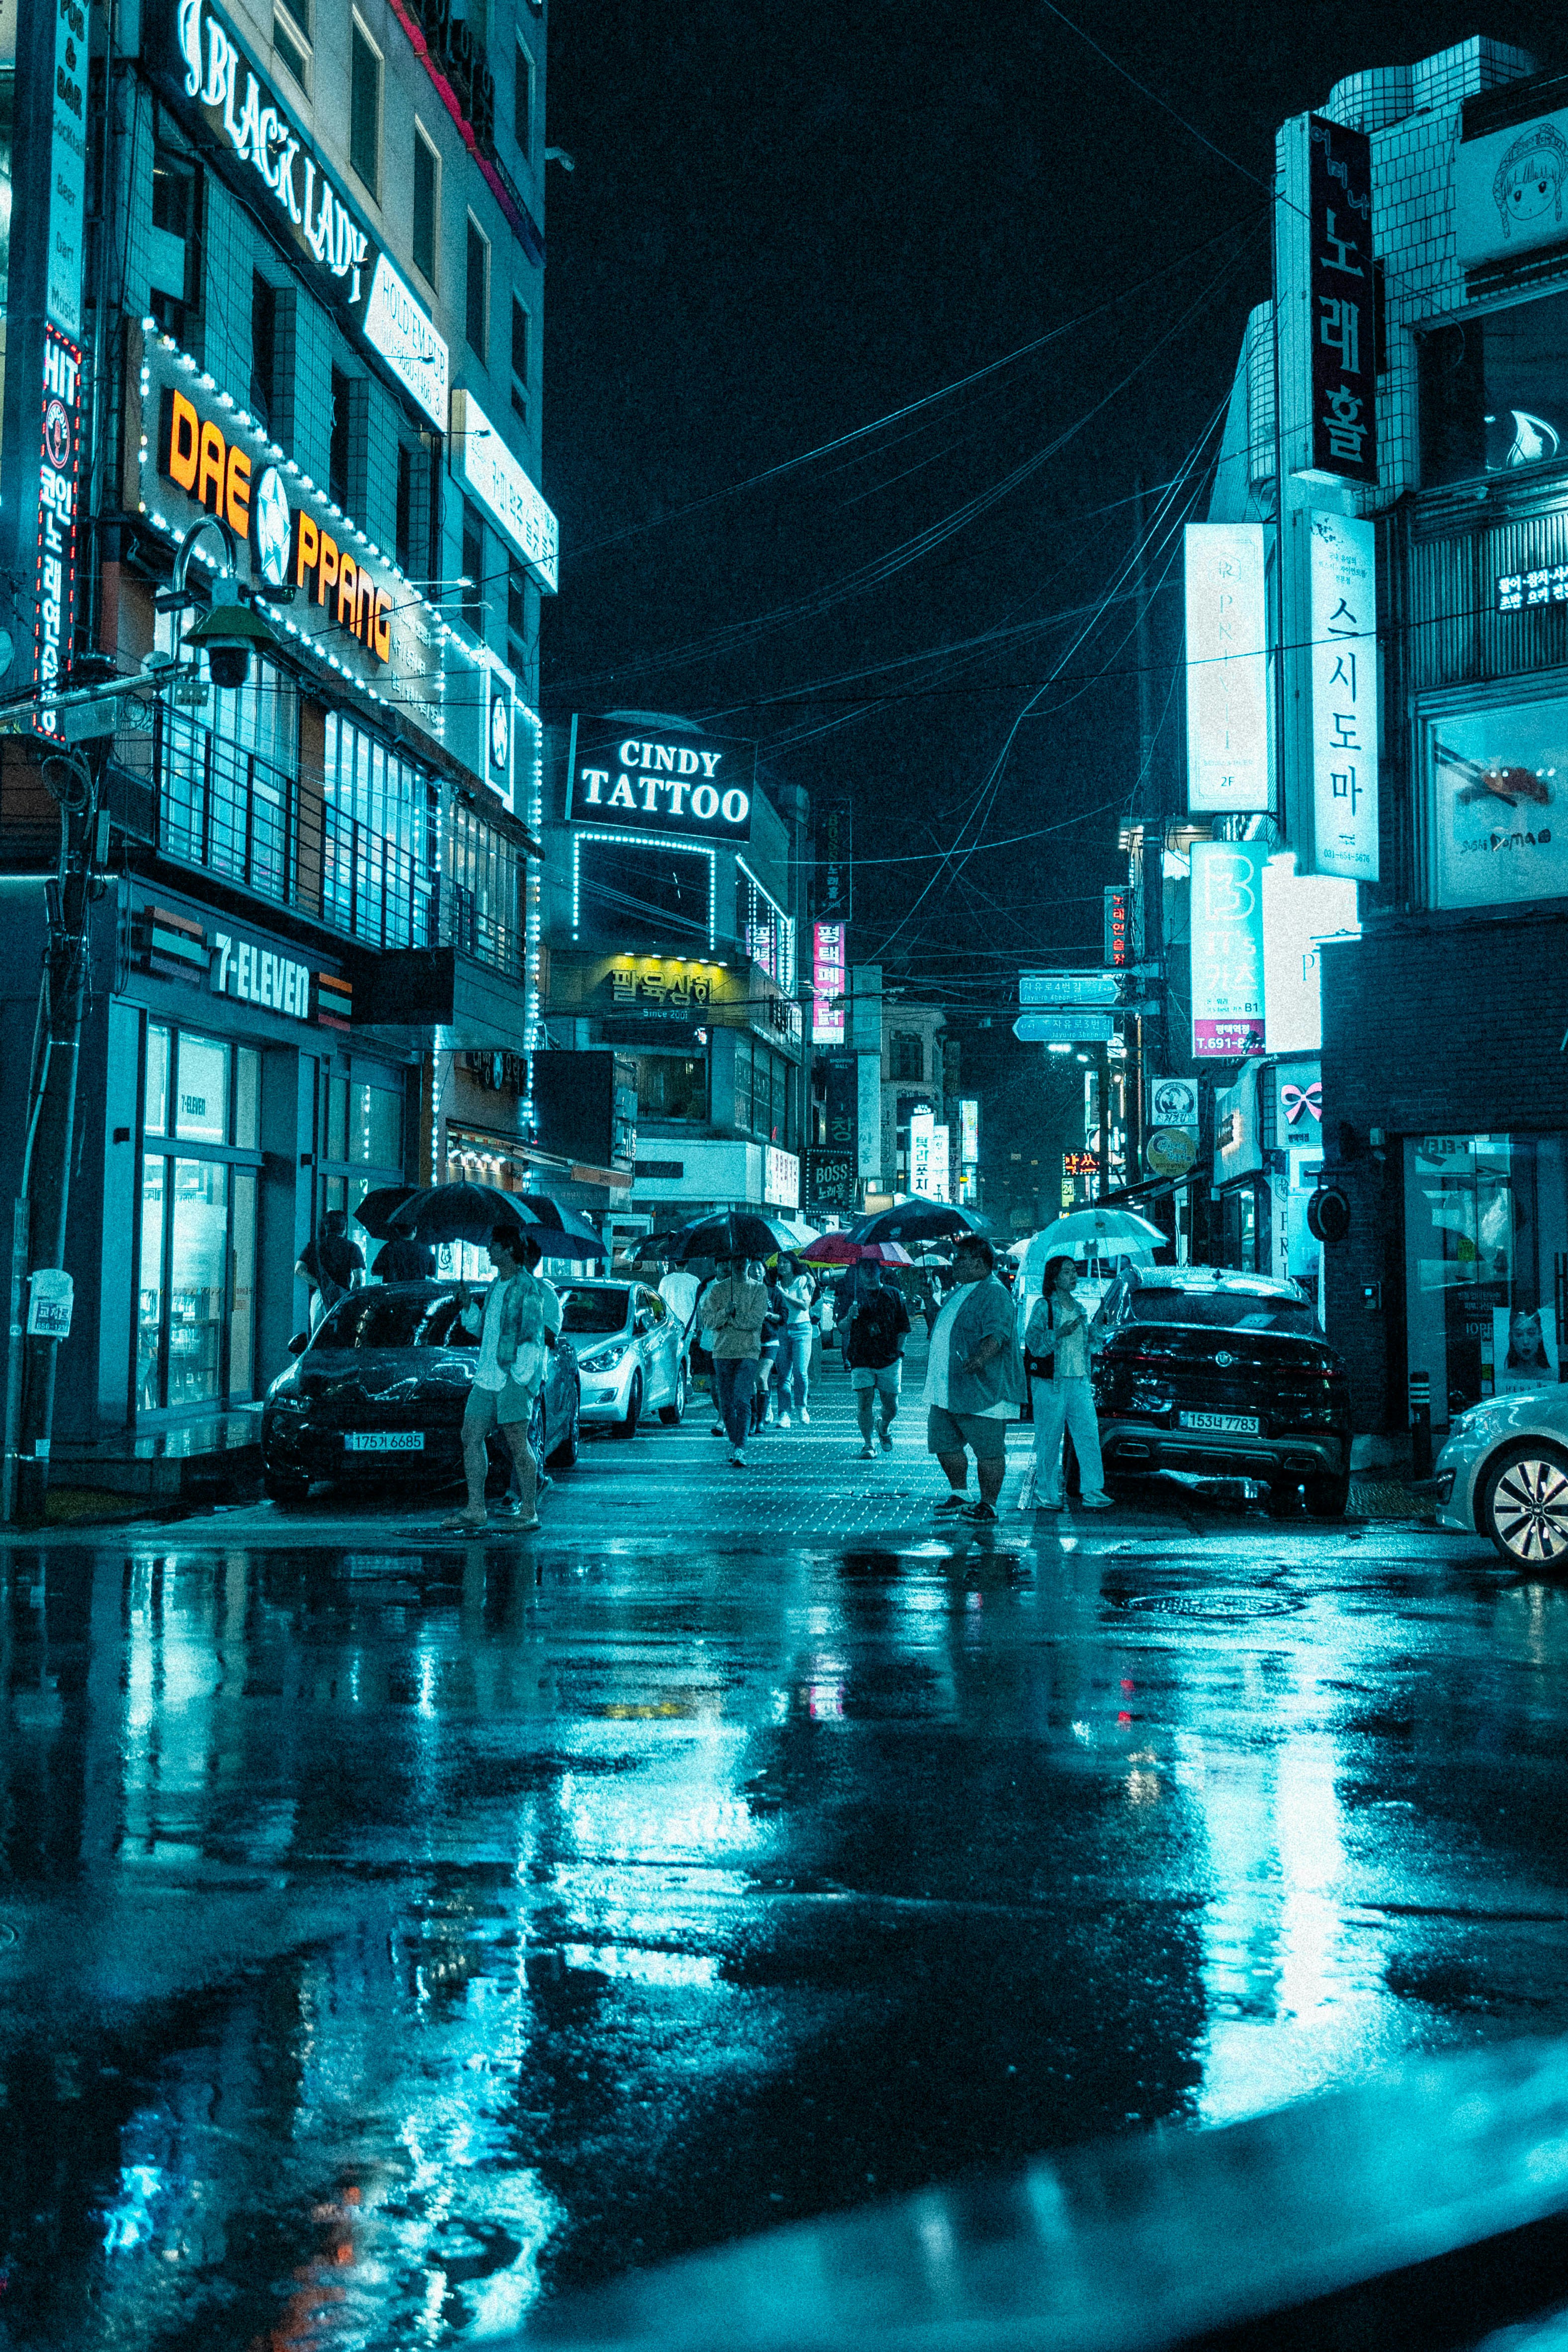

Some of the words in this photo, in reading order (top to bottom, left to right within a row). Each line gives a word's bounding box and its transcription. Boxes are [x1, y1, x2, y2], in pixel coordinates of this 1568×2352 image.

[57, 65, 83, 120] BAR
[201, 16, 301, 224] BLACK
[304, 157, 368, 303] LADY
[1320, 207, 1365, 464] 노래홀
[45, 338, 78, 406] HIT
[170, 389, 251, 539] DAE
[297, 509, 393, 664] PPANG
[1327, 598, 1363, 817] 스시도마
[618, 740, 722, 778] CINDY
[581, 768, 750, 823] TATTOO
[1220, 777, 1235, 786] 2F
[216, 932, 309, 1019] 7-ELEVEN
[1024, 982, 1082, 993] 자유로4번길
[643, 1008, 667, 1018] Since
[1245, 1003, 1258, 1012] B1
[1052, 1020, 1110, 1030] 자유로3번길
[181, 1094, 206, 1117] 7-ELEVEN
[816, 1164, 848, 1184] BOSS
[1225, 1417, 1256, 1431] 7783
[390, 1435, 421, 1448] 6685
